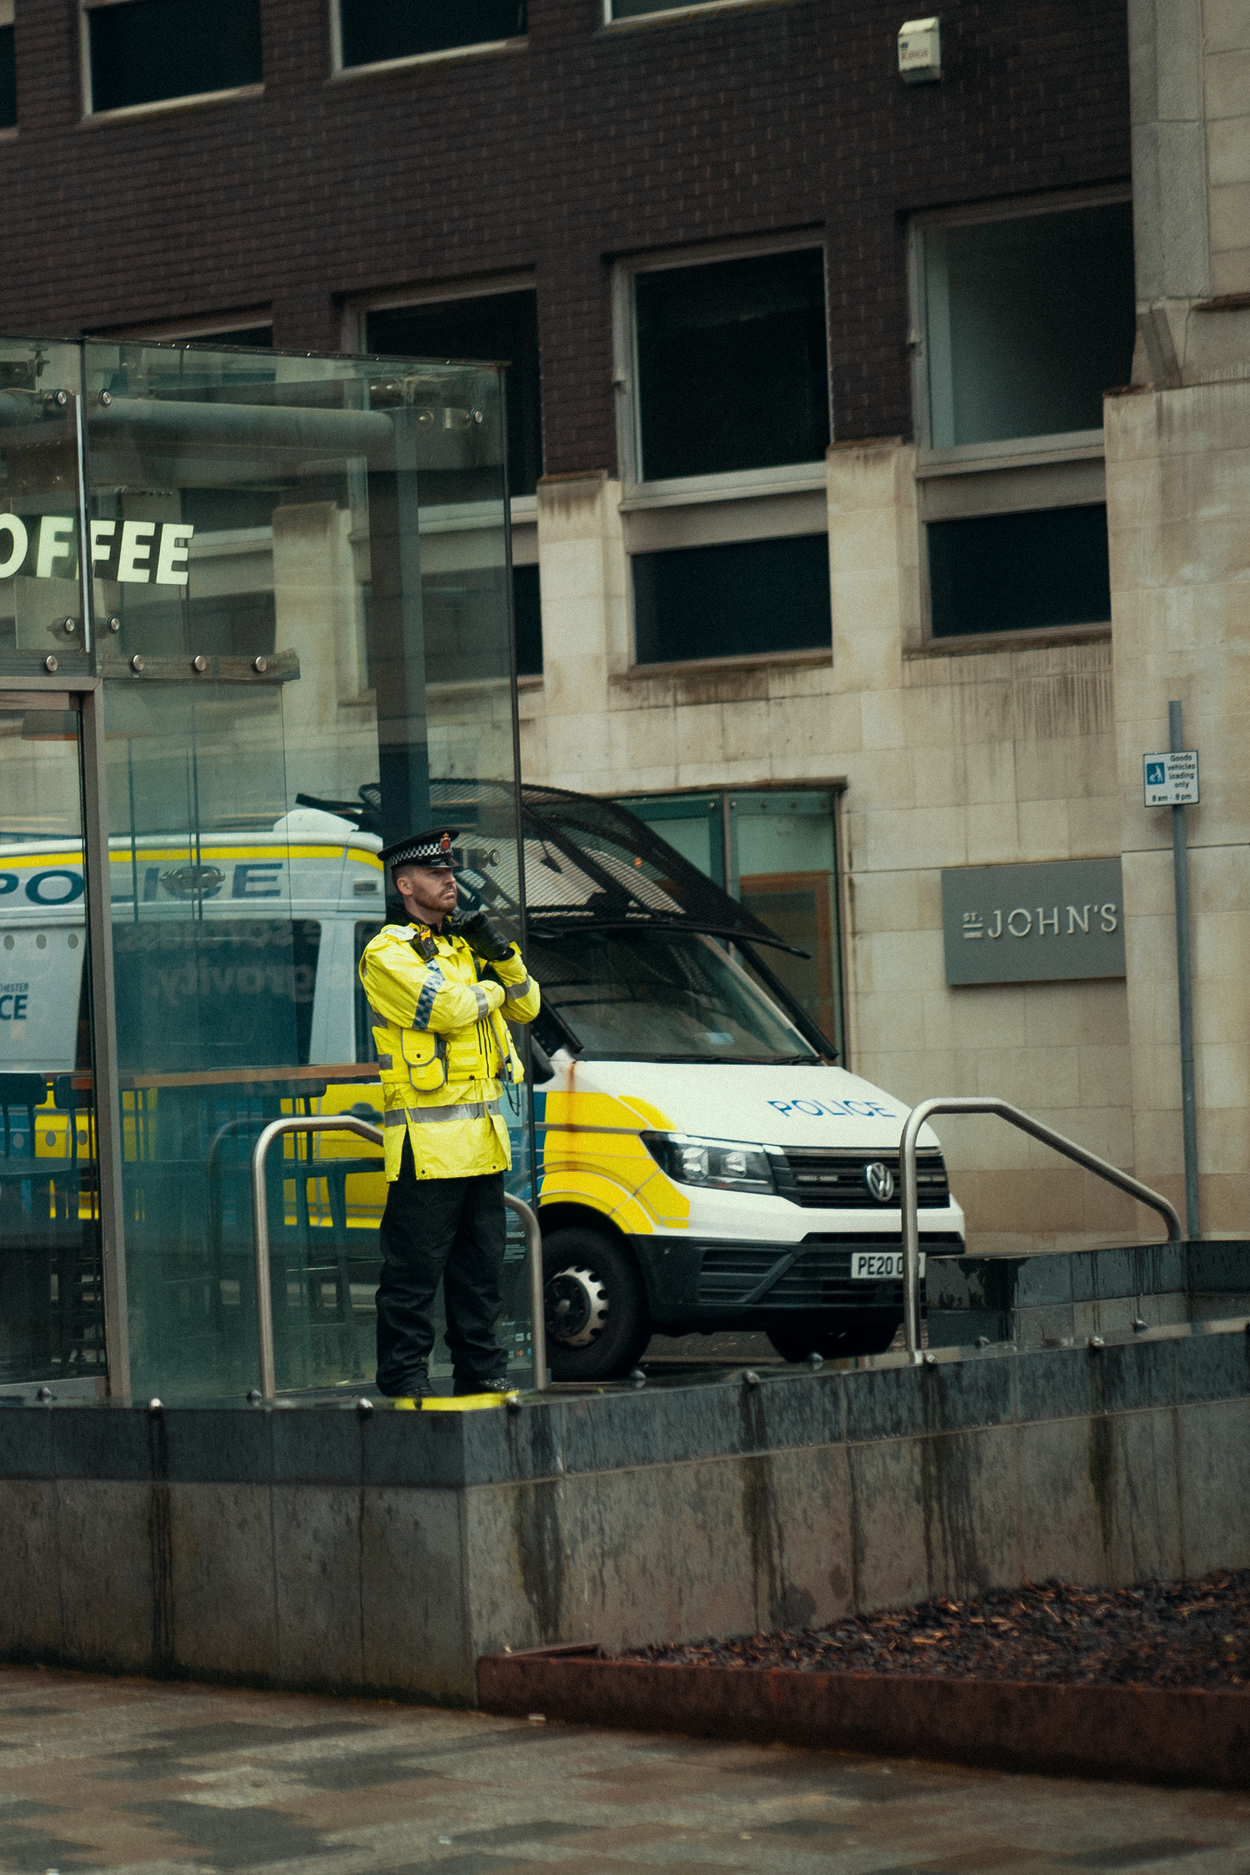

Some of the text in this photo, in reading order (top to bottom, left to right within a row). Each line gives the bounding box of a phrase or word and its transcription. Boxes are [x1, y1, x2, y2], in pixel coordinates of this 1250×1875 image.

[1169, 772, 1194, 780] loading
[1174, 780, 1189, 789] only
[987, 903, 1118, 938] JOHN'S
[767, 1100, 897, 1118] POLICE
[858, 1255, 893, 1276] PE20
